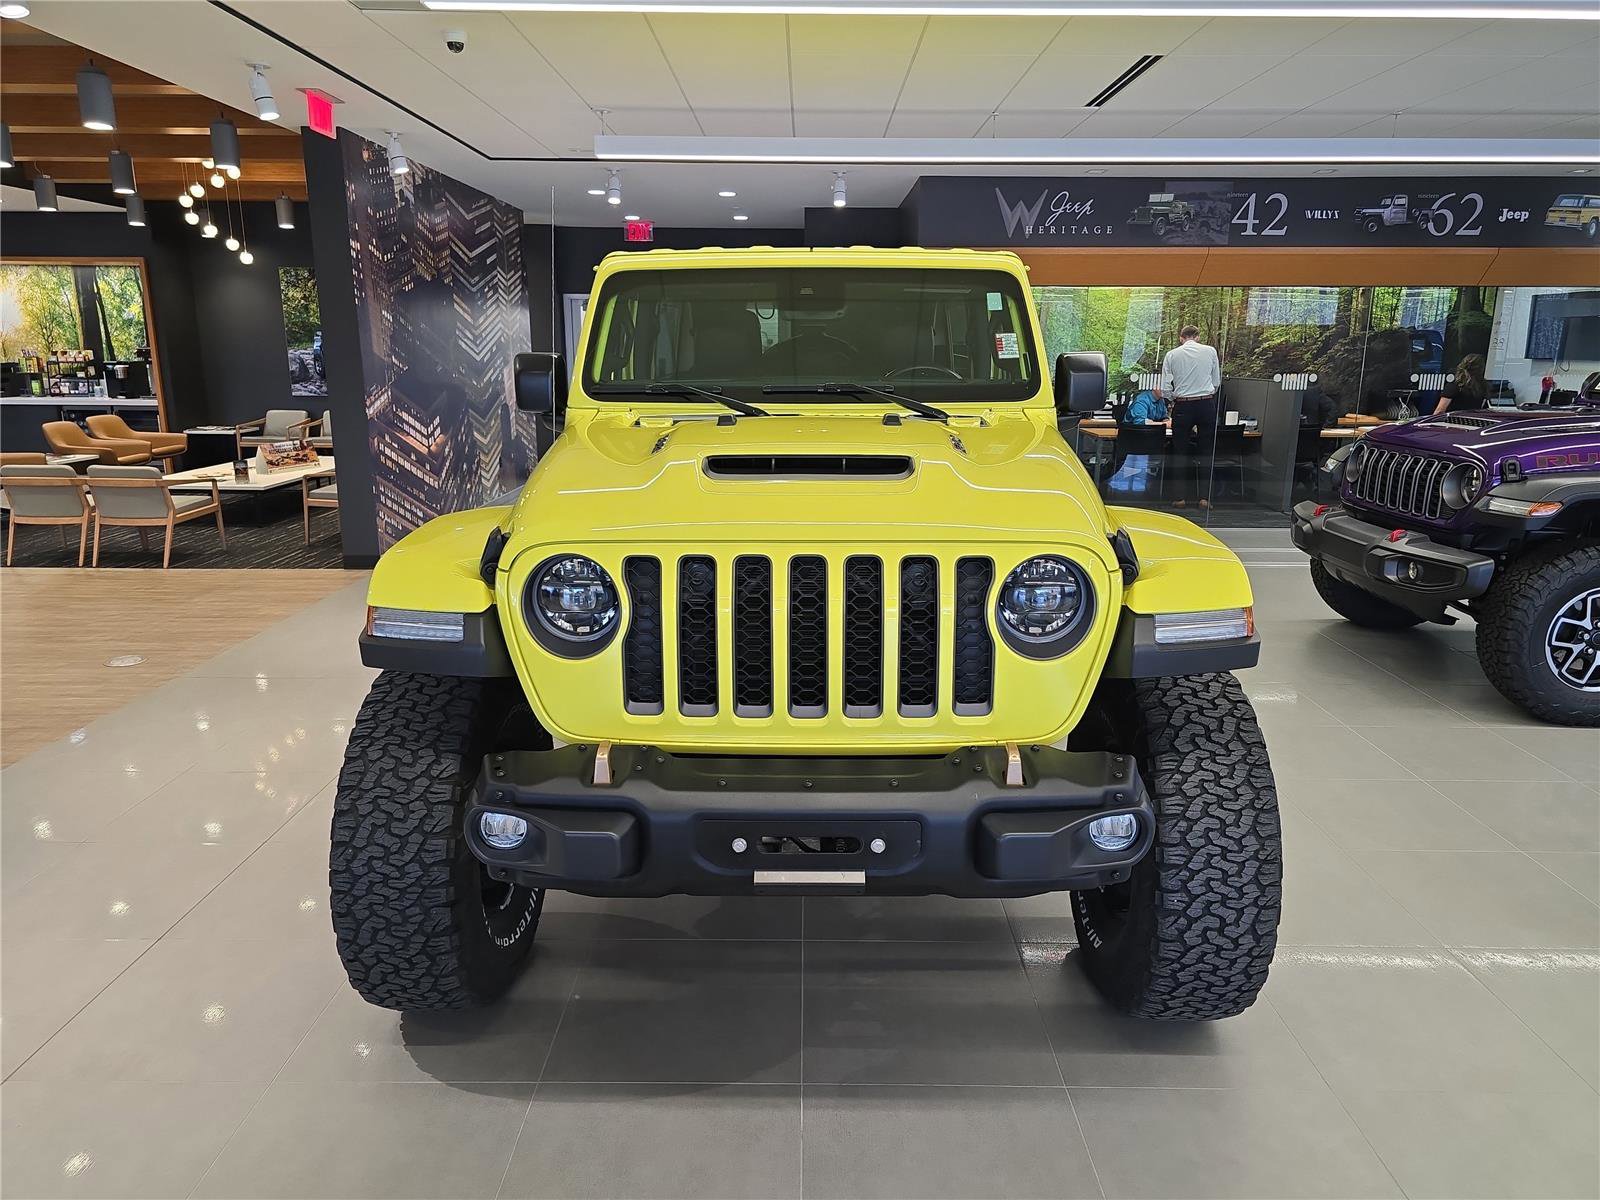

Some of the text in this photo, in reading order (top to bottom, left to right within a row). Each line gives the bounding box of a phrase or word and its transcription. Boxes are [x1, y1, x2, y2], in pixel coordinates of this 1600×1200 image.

[1045, 191, 1094, 226] Jeep
[1231, 192, 1290, 236] 42
[1304, 209, 1341, 220] WILLYS
[1427, 192, 1484, 237] 62
[1025, 225, 1114, 235] HERITAGE
[1536, 452, 1600, 468] RU
[1078, 891, 1103, 949] All-Ter
